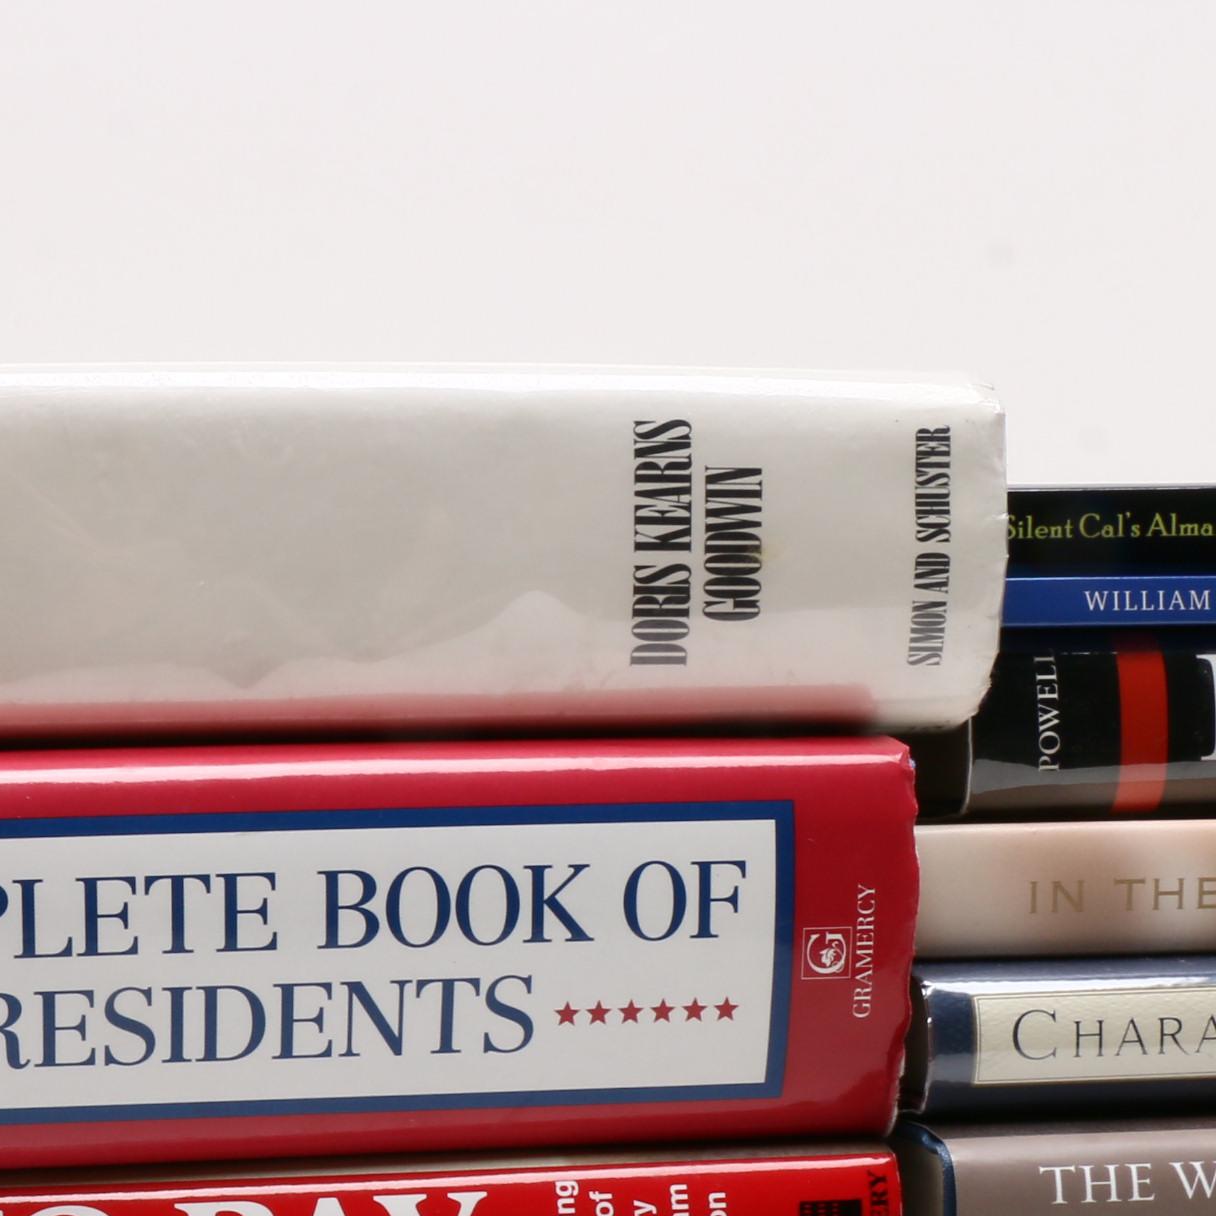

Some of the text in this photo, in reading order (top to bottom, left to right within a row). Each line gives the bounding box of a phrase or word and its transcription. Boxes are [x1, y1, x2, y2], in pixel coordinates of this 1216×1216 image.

[629, 419, 692, 666] DORIS KEARNS
[702, 465, 763, 622] GOODWIN
[907, 424, 951, 666] SIMON AND SCHUSTER
[1078, 511, 1141, 539] Cal's
[1146, 511, 1215, 538] Alma
[1083, 589, 1212, 612] WILLIAM
[317, 863, 595, 950] BOOK
[623, 859, 747, 942] OF
[1029, 876, 1216, 914] IN THE
[852, 883, 878, 1019] GRAMERCY
[1039, 1161, 1156, 1206] THE
